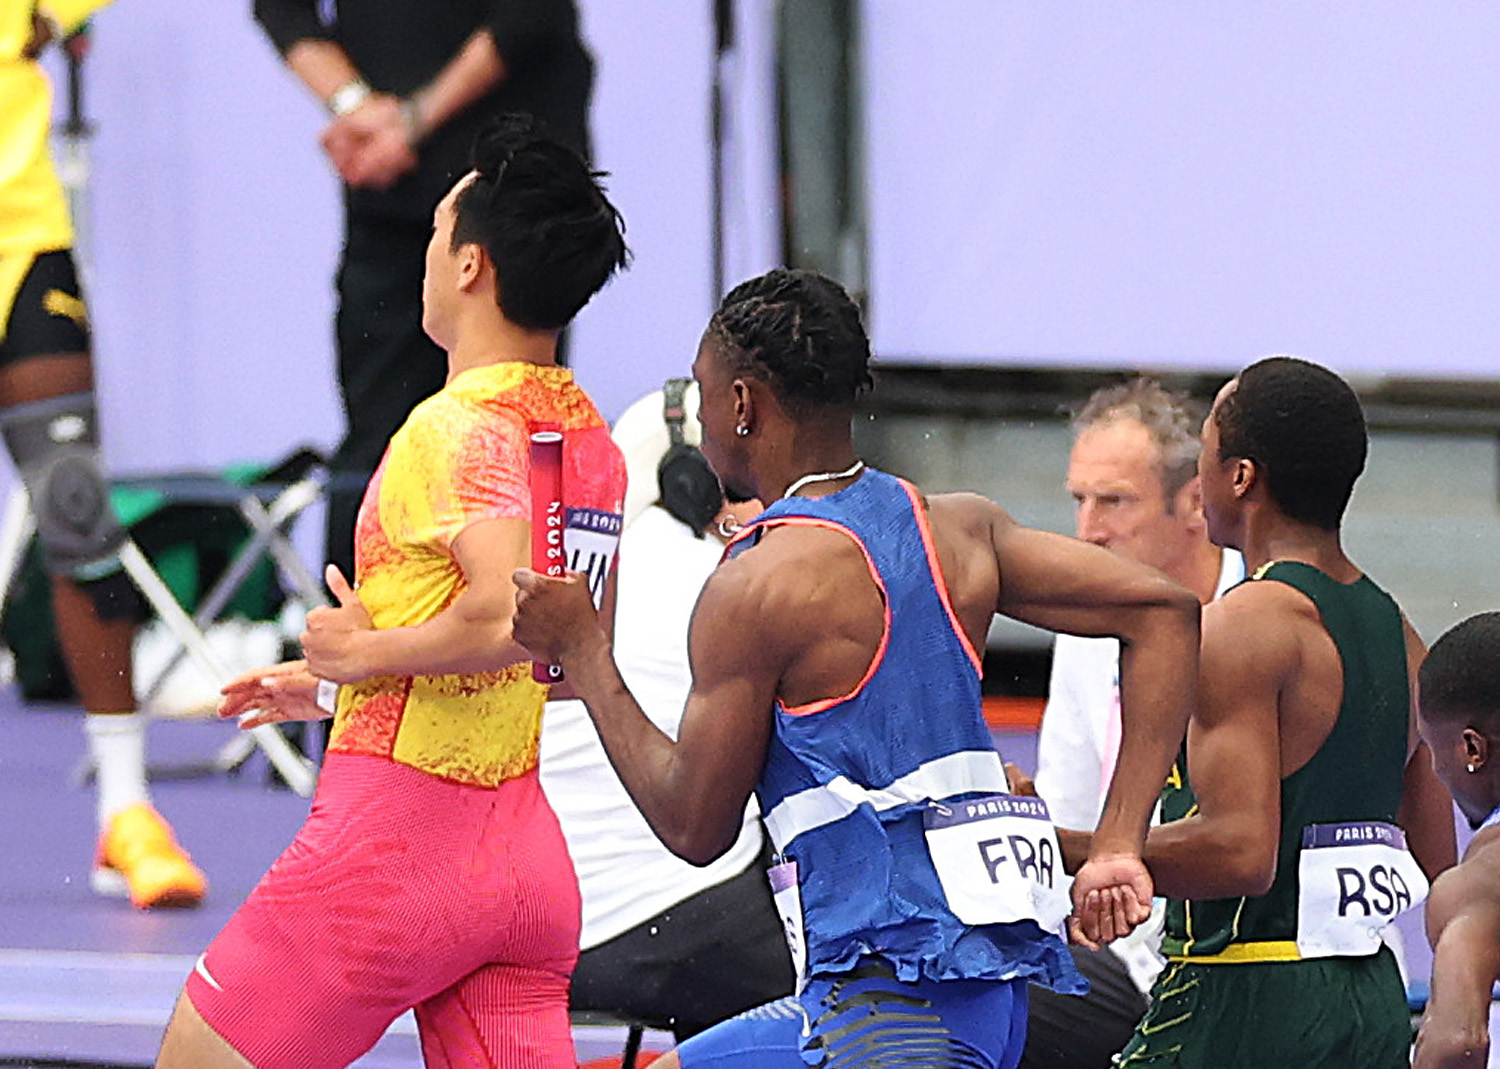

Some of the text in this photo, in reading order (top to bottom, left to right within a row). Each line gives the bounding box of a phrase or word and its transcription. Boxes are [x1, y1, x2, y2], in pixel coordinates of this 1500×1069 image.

[967, 800, 1046, 817] PARIS 2024
[1335, 826, 1375, 841] PARIS
[977, 834, 1053, 889] FRA
[1335, 864, 1411, 916] RSA
